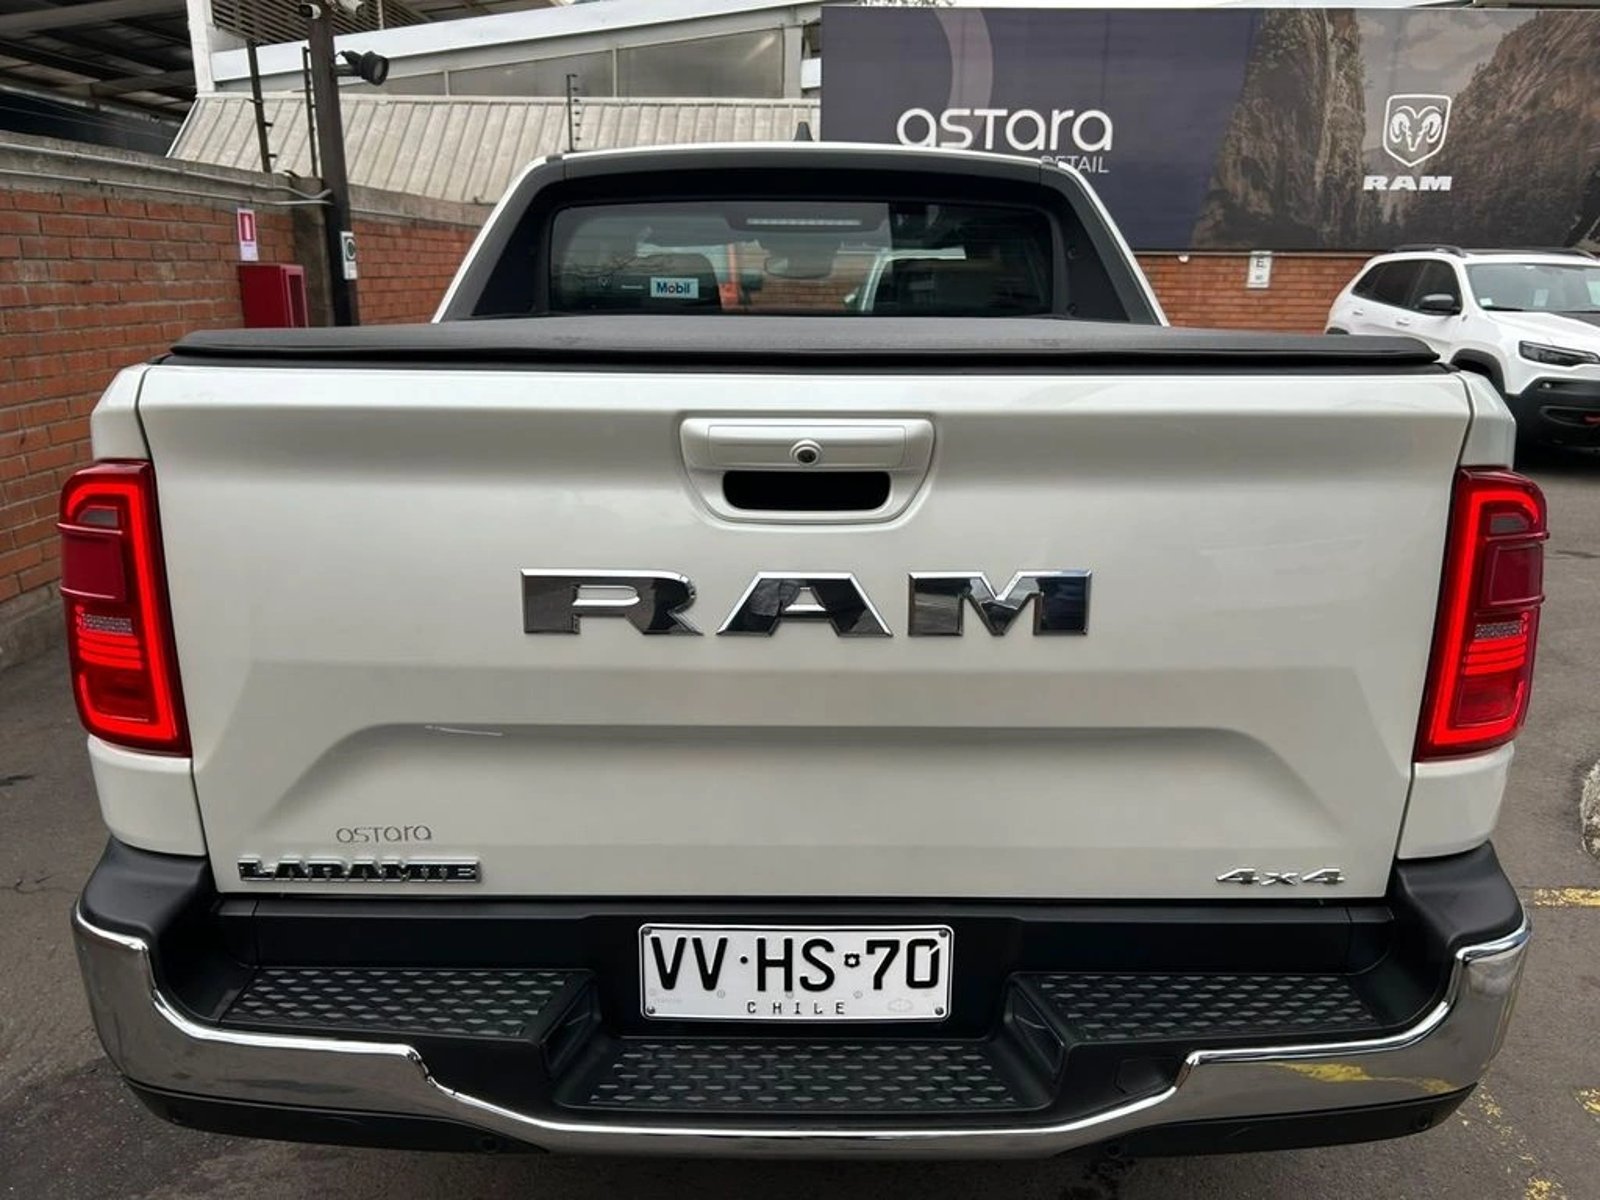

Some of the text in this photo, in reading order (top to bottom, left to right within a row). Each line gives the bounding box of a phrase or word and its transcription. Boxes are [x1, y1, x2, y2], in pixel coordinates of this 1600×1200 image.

[897, 108, 1113, 152] astara
[1363, 175, 1453, 191] RAM
[656, 282, 691, 294] Mobil
[521, 567, 1092, 637] RAM
[336, 825, 433, 844] astara
[237, 854, 481, 883] LARAMIE
[1216, 867, 1345, 886] 4x4
[746, 1001, 845, 1016] CHILE
